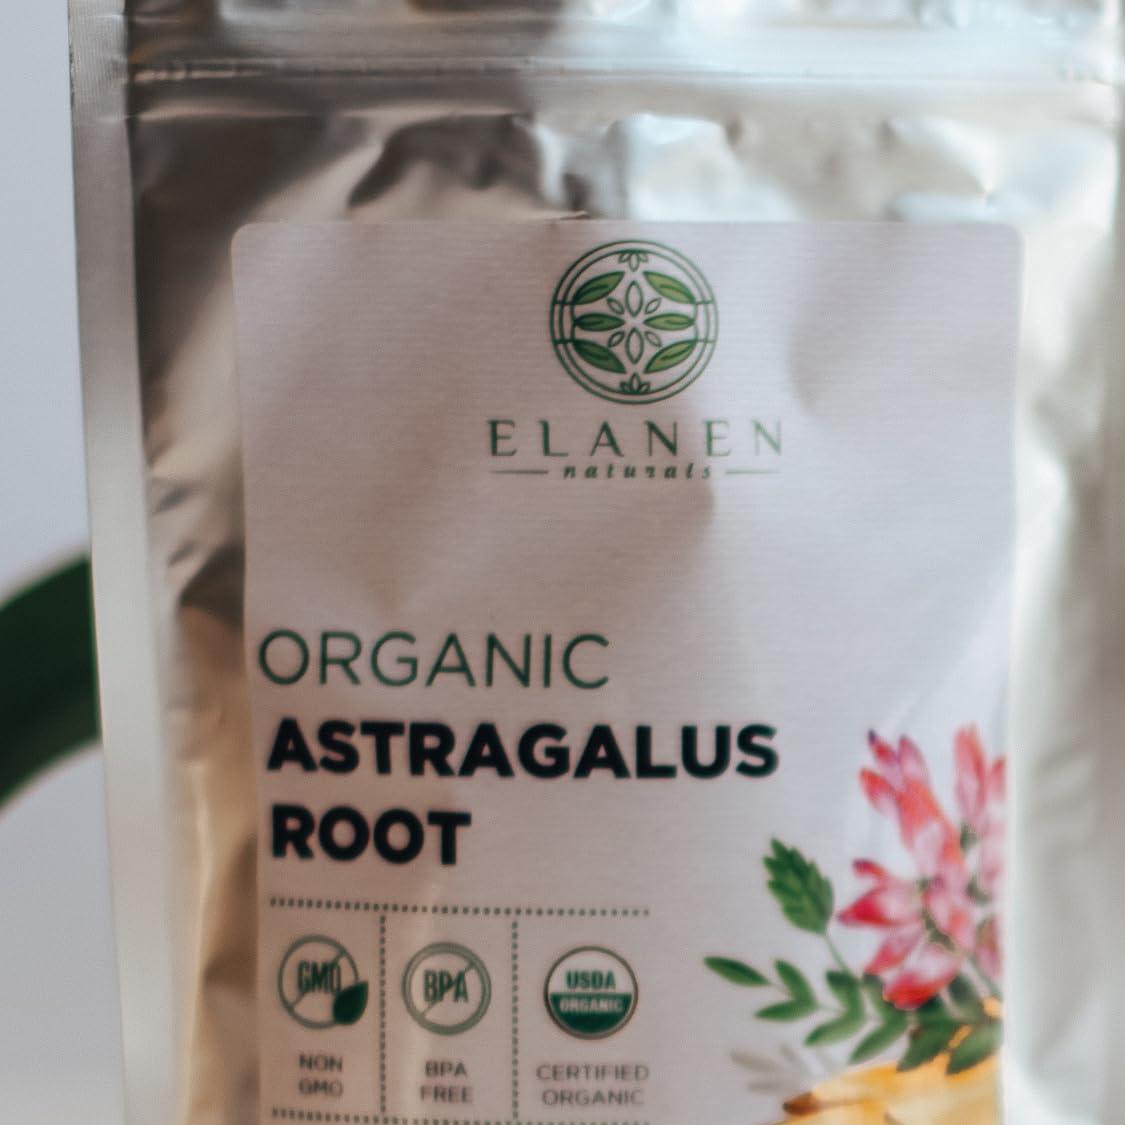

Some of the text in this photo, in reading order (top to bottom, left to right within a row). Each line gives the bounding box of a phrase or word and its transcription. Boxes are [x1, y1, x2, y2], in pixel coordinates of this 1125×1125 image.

[487, 419, 782, 457] ELANEN
[563, 463, 711, 479] naturals
[258, 629, 610, 689] ORGANIC
[266, 717, 779, 779] ASTRAGALUS
[271, 804, 471, 865] ROOT
[296, 959, 341, 995] GMO
[423, 969, 468, 1003] BPA
[566, 970, 615, 990] USDA
[559, 998, 623, 1014] ORGANIC
[298, 1054, 343, 1074] NON
[425, 1060, 467, 1078] BPA
[536, 1063, 650, 1082] CERTIFIED
[298, 1078, 344, 1098] GMO
[420, 1086, 473, 1104] FREE
[542, 1088, 645, 1107] ORGANIC
